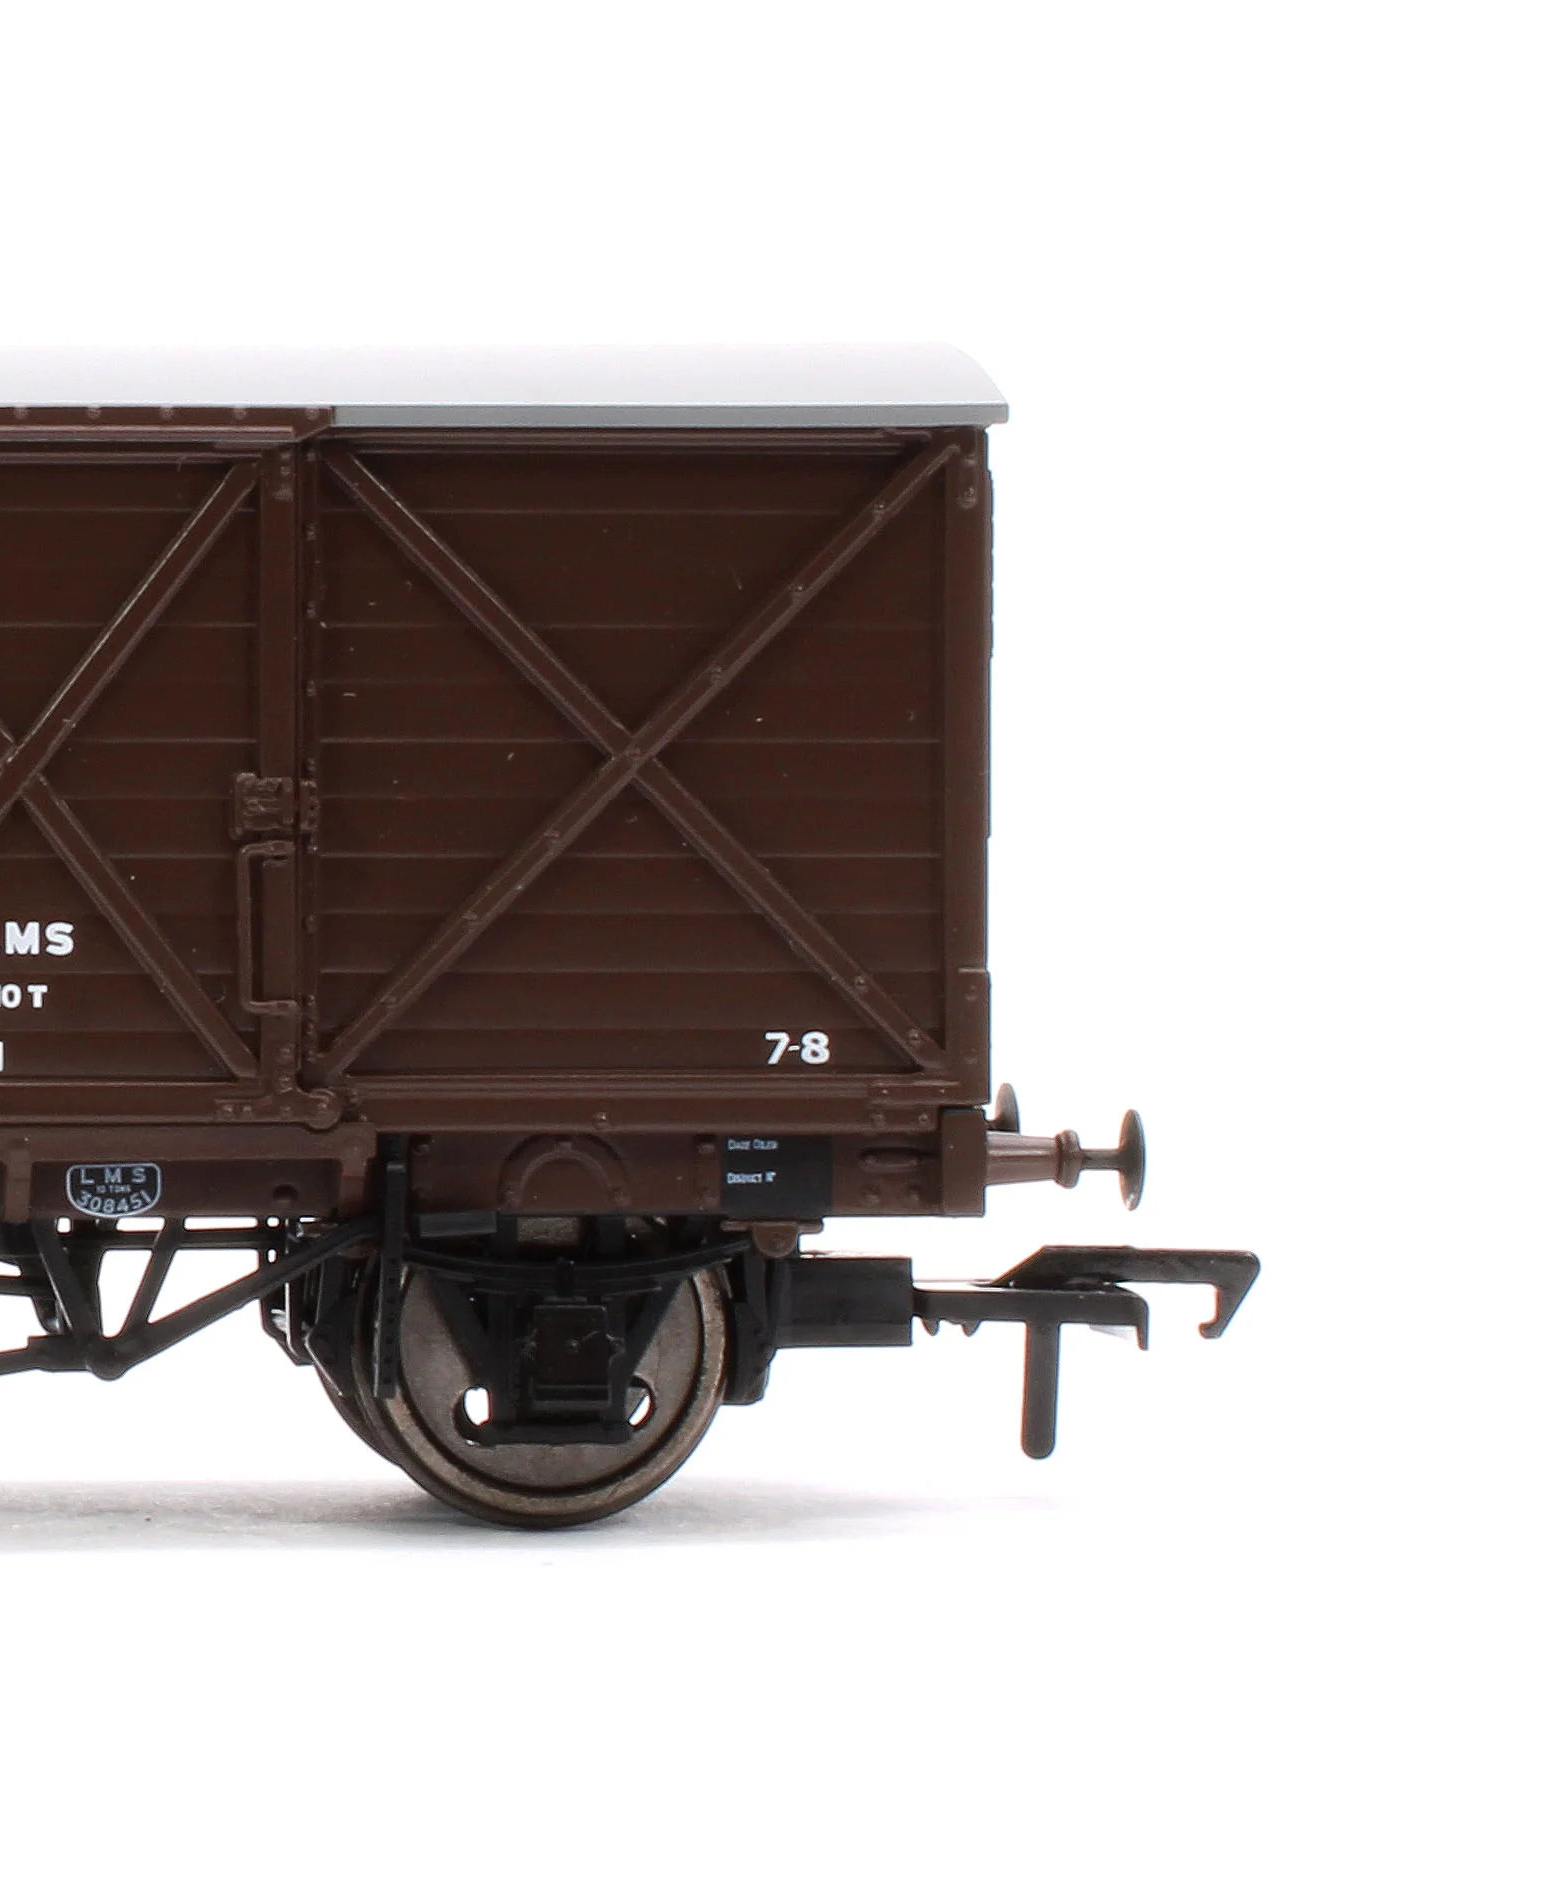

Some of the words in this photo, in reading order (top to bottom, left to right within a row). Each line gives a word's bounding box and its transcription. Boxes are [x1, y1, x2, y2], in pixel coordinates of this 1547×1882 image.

[27, 984, 48, 1008] T
[765, 1031, 831, 1065] 7-8
[76, 1190, 151, 1213] 308451
